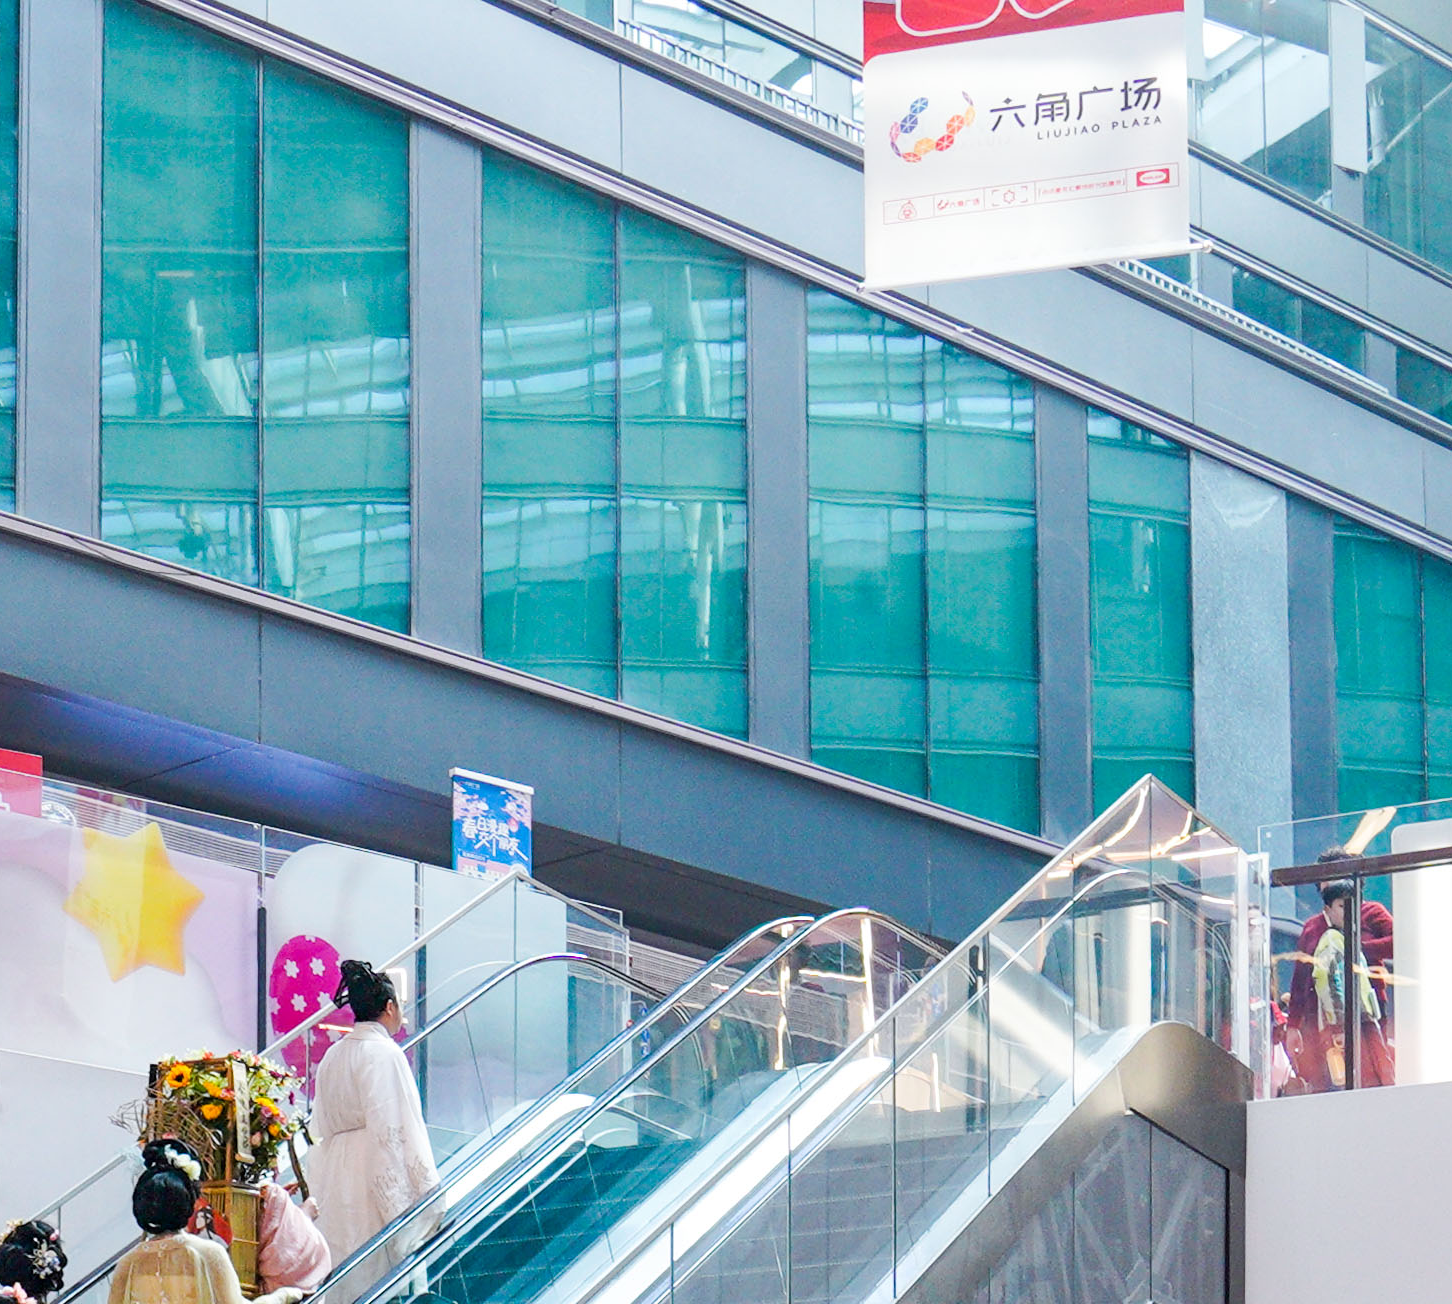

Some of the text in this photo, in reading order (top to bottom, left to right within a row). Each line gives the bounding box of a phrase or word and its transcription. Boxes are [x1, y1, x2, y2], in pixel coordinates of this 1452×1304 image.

[989, 76, 1162, 132] 六角广场
[1036, 115, 1163, 141] LIUJIAO PLAZA
